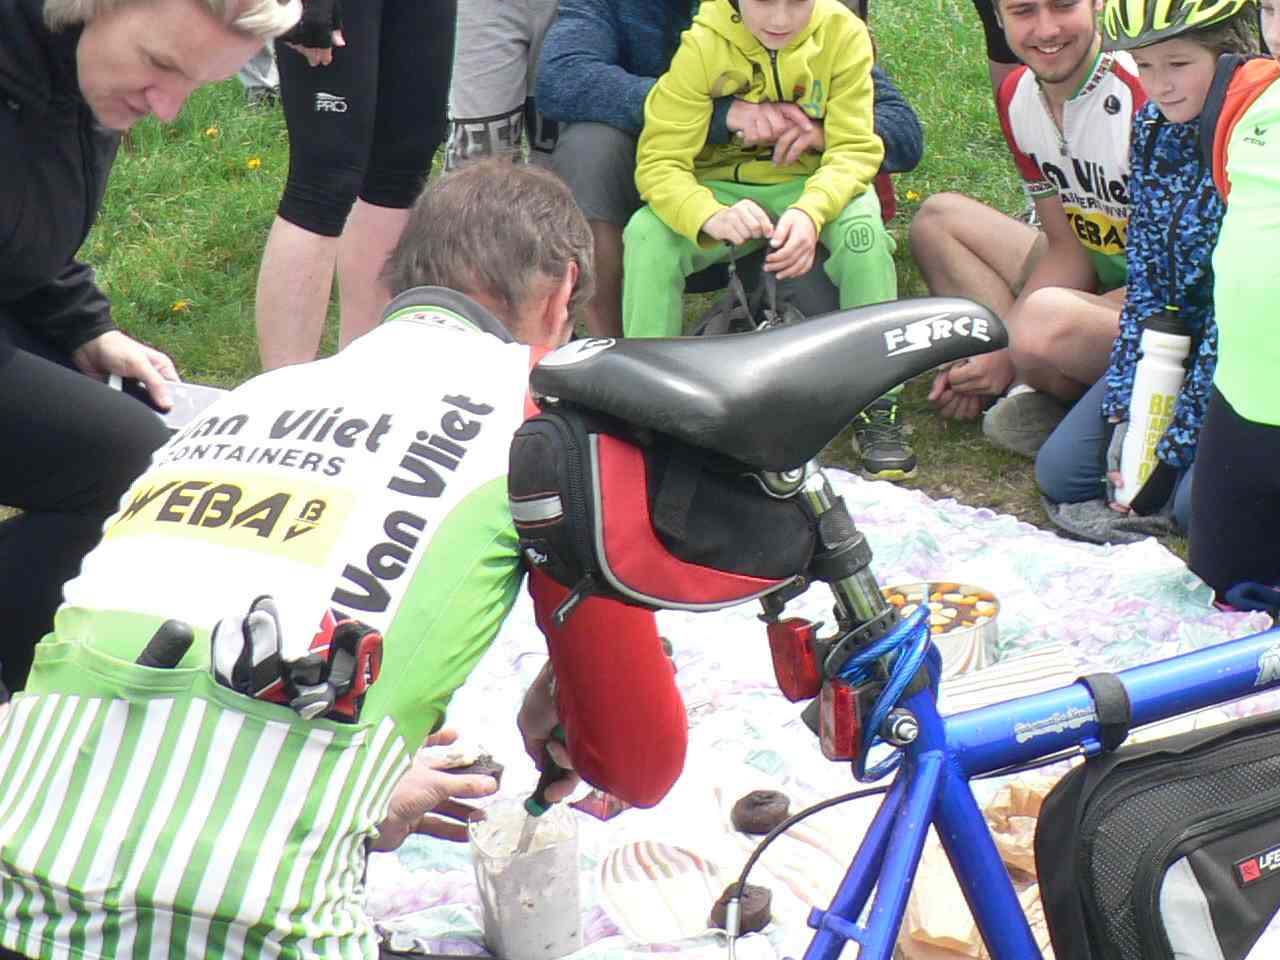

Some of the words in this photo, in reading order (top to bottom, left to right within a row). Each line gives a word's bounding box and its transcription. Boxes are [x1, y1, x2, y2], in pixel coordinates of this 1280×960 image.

[1072, 158, 1130, 206] Vlie
[850, 226, 870, 248] 08
[883, 312, 991, 357] FORCE
[172, 413, 249, 444] an
[269, 407, 393, 453] Vliet
[331, 509, 427, 613] Van
[387, 393, 495, 498] Vliet
